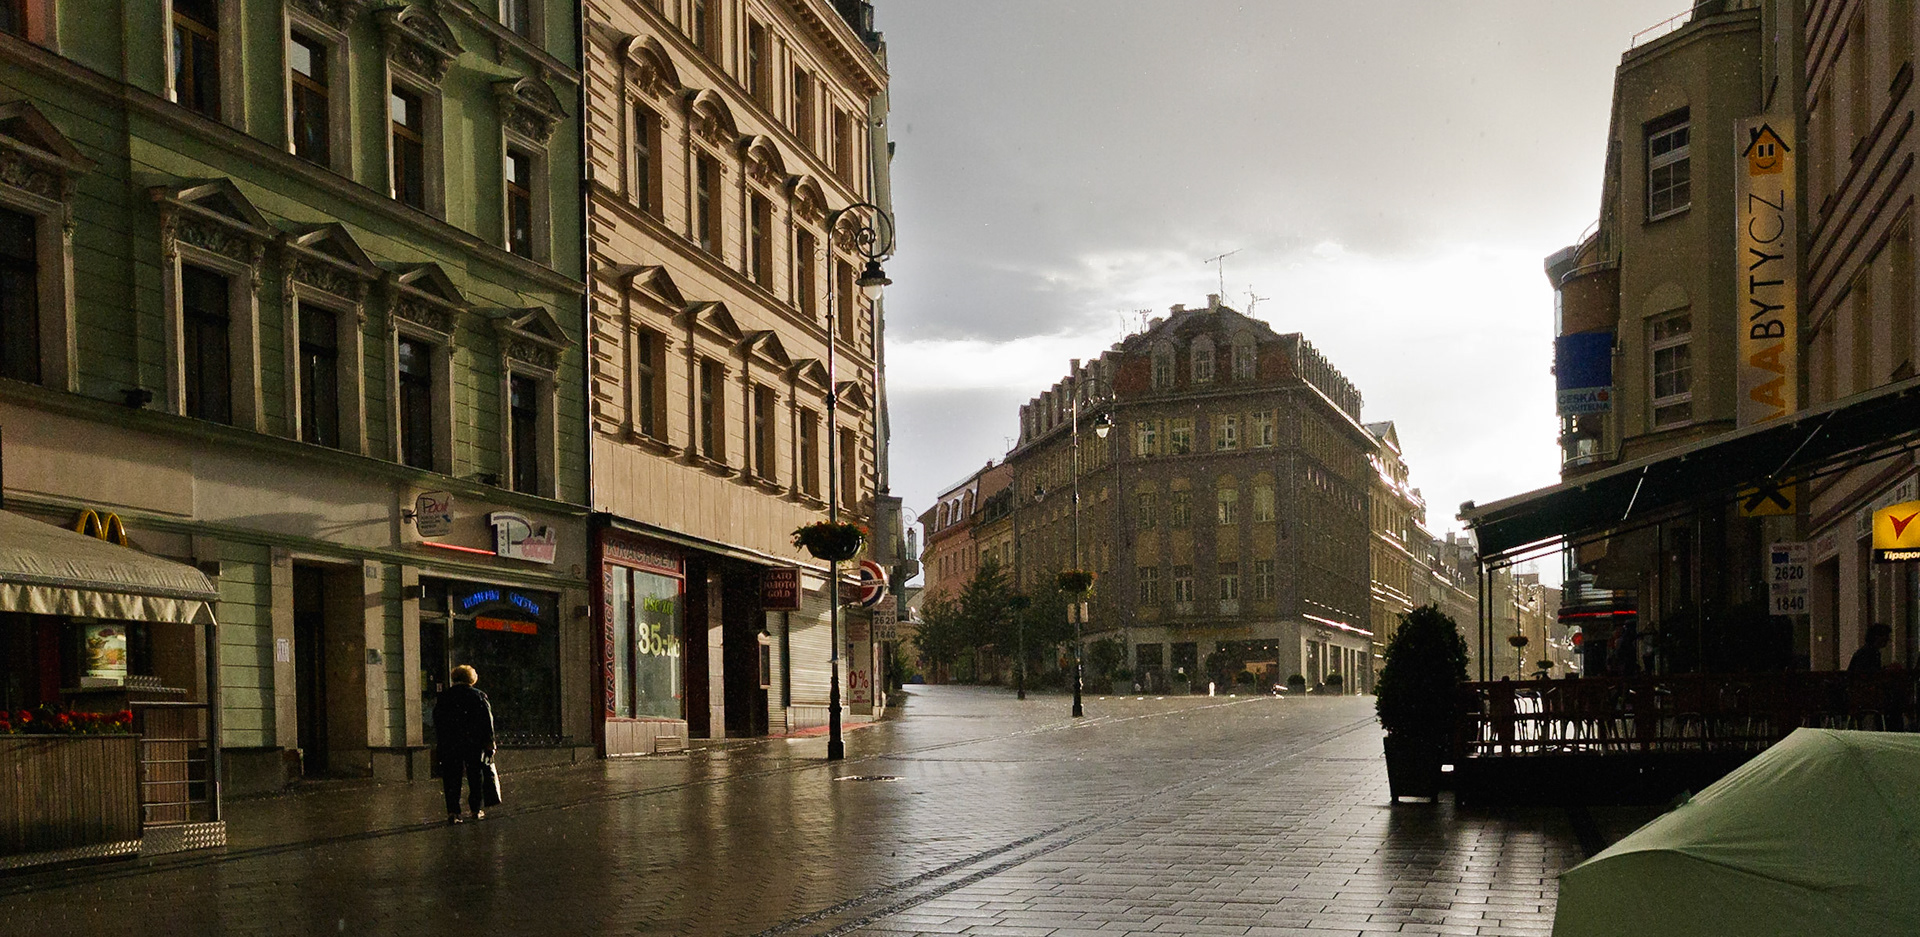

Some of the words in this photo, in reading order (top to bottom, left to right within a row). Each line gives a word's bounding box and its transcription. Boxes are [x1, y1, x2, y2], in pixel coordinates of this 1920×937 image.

[1775, 566, 1804, 580] 2620
[1776, 596, 1804, 611] 1840
[874, 616, 896, 625] 2620
[875, 631, 896, 639] 1840
